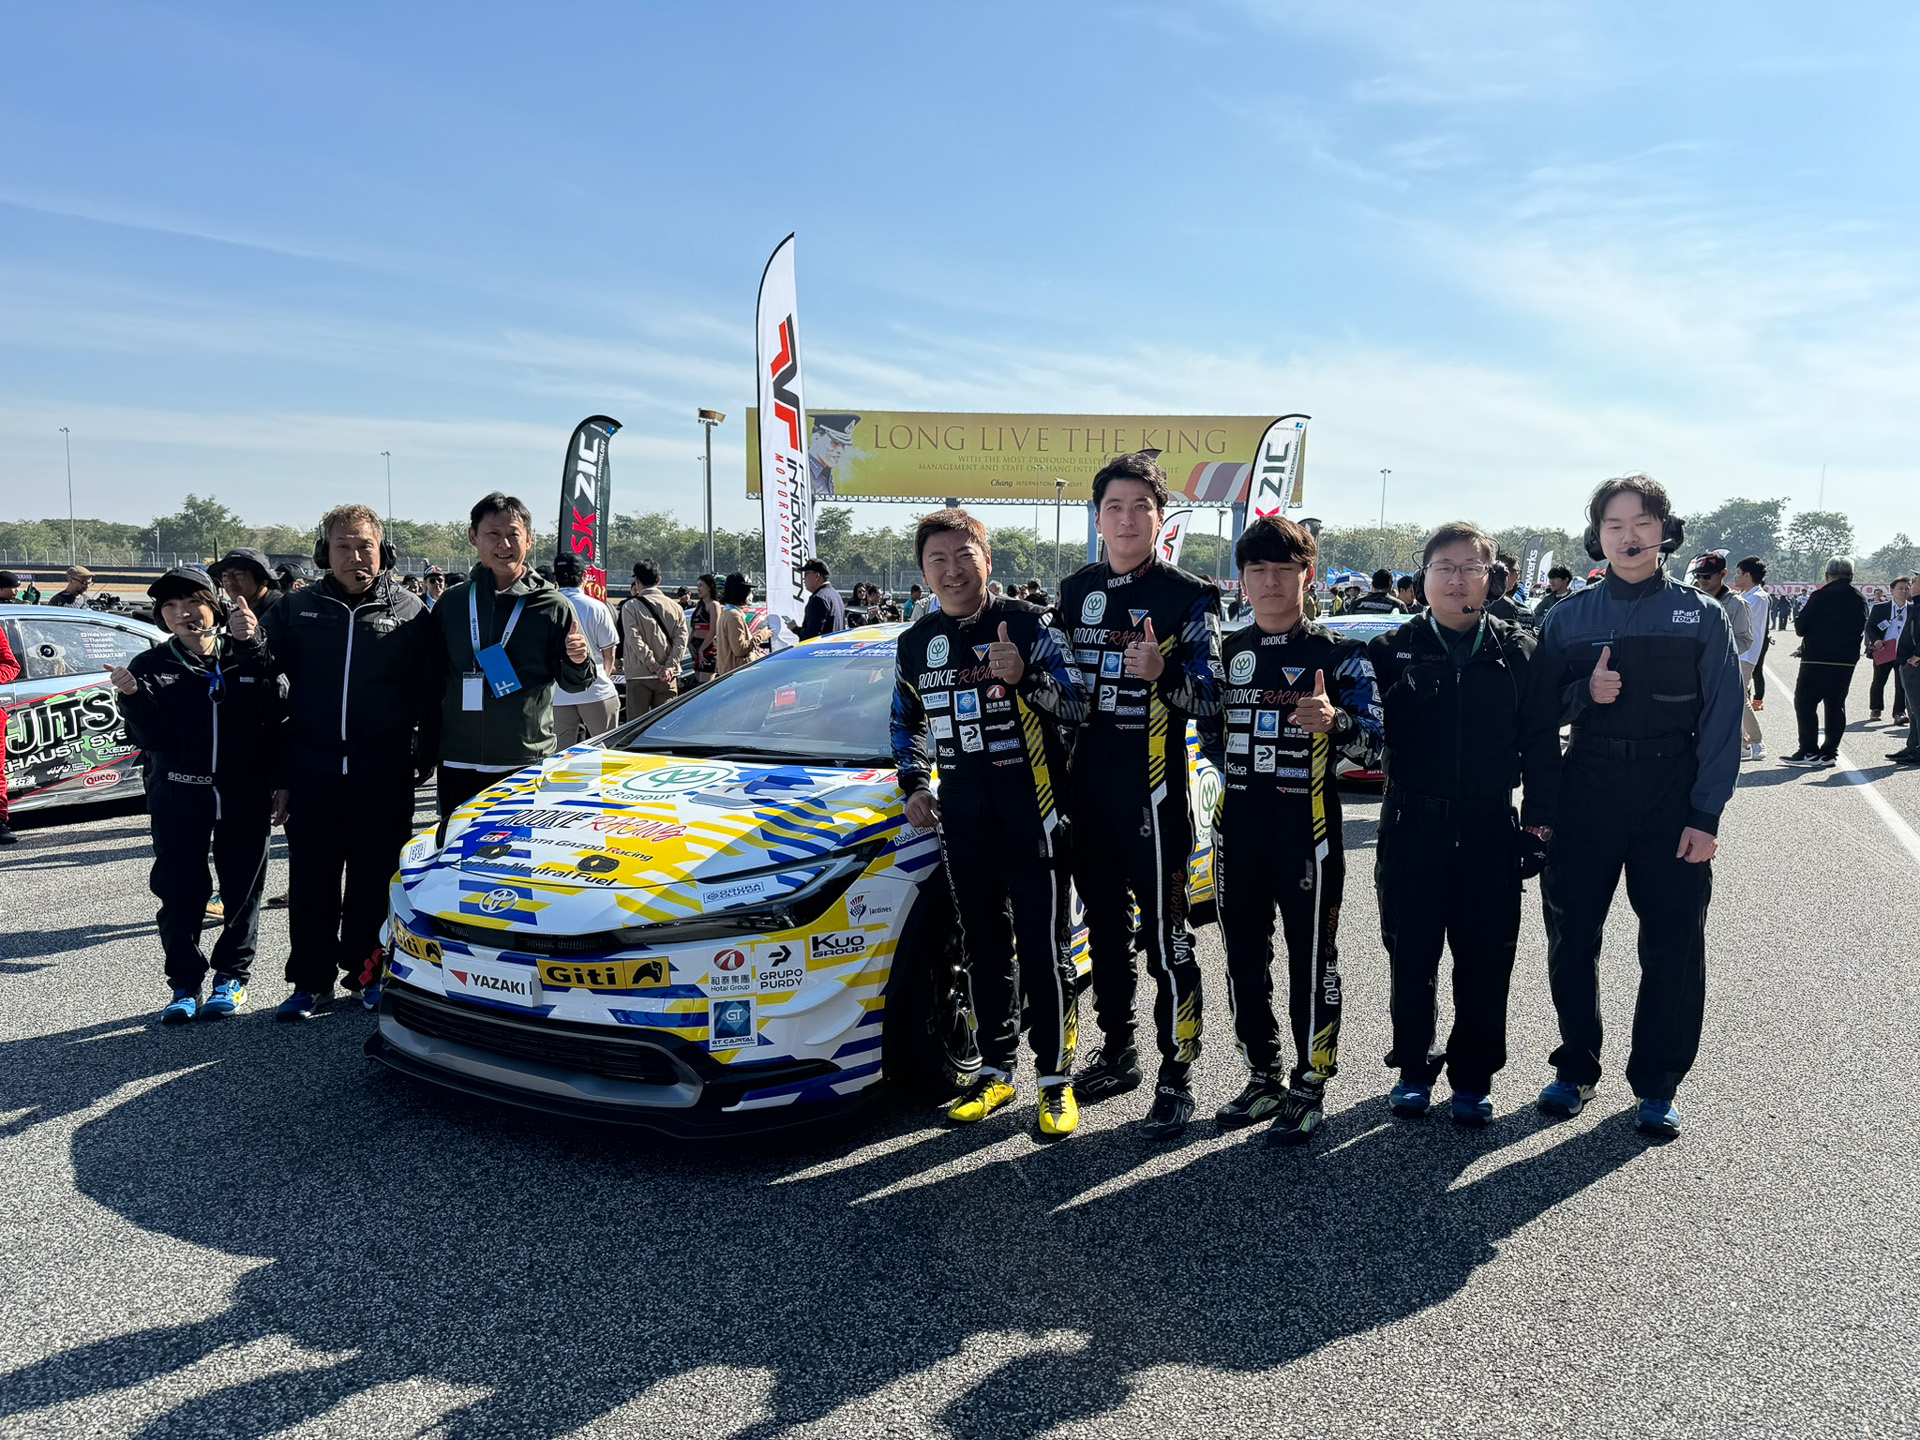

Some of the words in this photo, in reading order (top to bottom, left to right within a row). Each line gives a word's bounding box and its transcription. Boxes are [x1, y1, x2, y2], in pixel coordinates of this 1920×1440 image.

[873, 424, 965, 450] LONG
[981, 426, 1049, 451] LIVE
[1062, 428, 1126, 453] THE
[1141, 429, 1227, 455] KING
[918, 463, 978, 472] MANAGEMENT
[980, 464, 999, 472] AND
[1001, 464, 1024, 472] STAFF
[1041, 465, 1072, 473] CHANG
[958, 455, 984, 463] WITH
[985, 456, 1001, 464] THE
[1003, 456, 1027, 464] MOST
[1029, 456, 1076, 465] PROFOUND
[574, 431, 600, 507] ZIC
[1258, 441, 1291, 498] ZIC
[990, 478, 1014, 489] Chang
[775, 453, 790, 567] MOTORSPORT
[571, 506, 595, 560] SK
[1107, 573, 1133, 589] ROOKIE
[1764, 584, 1816, 595] ONDA
[1073, 628, 1110, 645] ROOKIE
[1261, 634, 1288, 646] ROOKIE
[918, 669, 958, 690] ROOKIE
[1225, 689, 1263, 705] ROOKIE
[97, 744, 134, 756] EXEDY
[86, 773, 117, 786] Queen
[168, 771, 213, 784] sparco
[497, 809, 599, 830] ROOKIE
[580, 815, 688, 843] RACING
[893, 829, 916, 847] Abdul
[504, 836, 554, 845] TOYOTA
[555, 840, 605, 852] GAZOO
[605, 847, 653, 862] Racing
[453, 859, 513, 873] Carbon
[510, 863, 573, 880] Neutral
[573, 872, 618, 887] Fuel
[869, 905, 892, 915] Jardines
[812, 945, 865, 958] GROUP
[546, 966, 617, 986] Giti
[759, 968, 803, 982] GRUPO
[1323, 960, 1341, 1005] ROOKIE
[471, 973, 526, 995] YAZAKI
[760, 977, 803, 990] PURDY
[726, 1008, 744, 1021] GT
